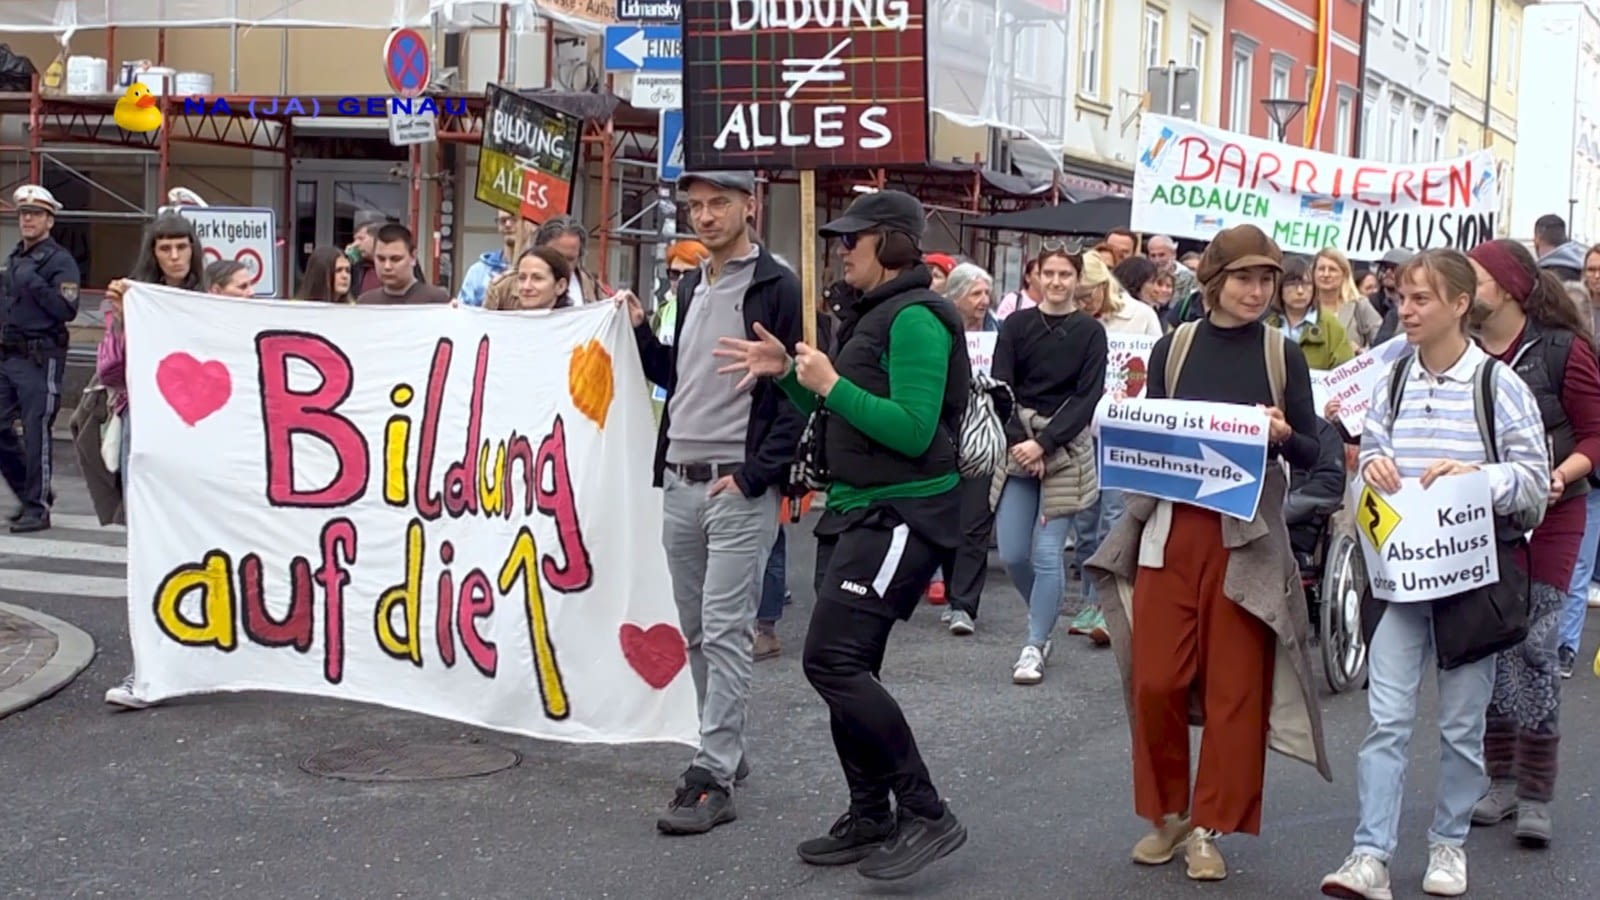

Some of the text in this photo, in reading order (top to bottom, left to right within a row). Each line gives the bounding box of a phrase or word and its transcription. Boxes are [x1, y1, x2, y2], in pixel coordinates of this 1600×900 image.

[493, 109, 565, 159] BILDUNG
[713, 101, 892, 149] ALLES
[493, 168, 548, 209] ALLES
[1174, 136, 1472, 208] BARRIEREN
[1151, 184, 1269, 217] ABBAUEN
[1273, 208, 1494, 252] MEHR INKLUSION
[1323, 356, 1375, 387] Teilhabe
[1107, 404, 1260, 436] Bildung ist keine
[254, 329, 592, 593] Bildung
[1109, 449, 1243, 482] Einbahnstraße
[1437, 504, 1486, 528] Kein
[1387, 534, 1489, 562] Abschluss
[841, 580, 868, 595] JAKO
[1402, 556, 1491, 591] Umweg!
[153, 517, 357, 684] auf
[375, 518, 497, 678] die
